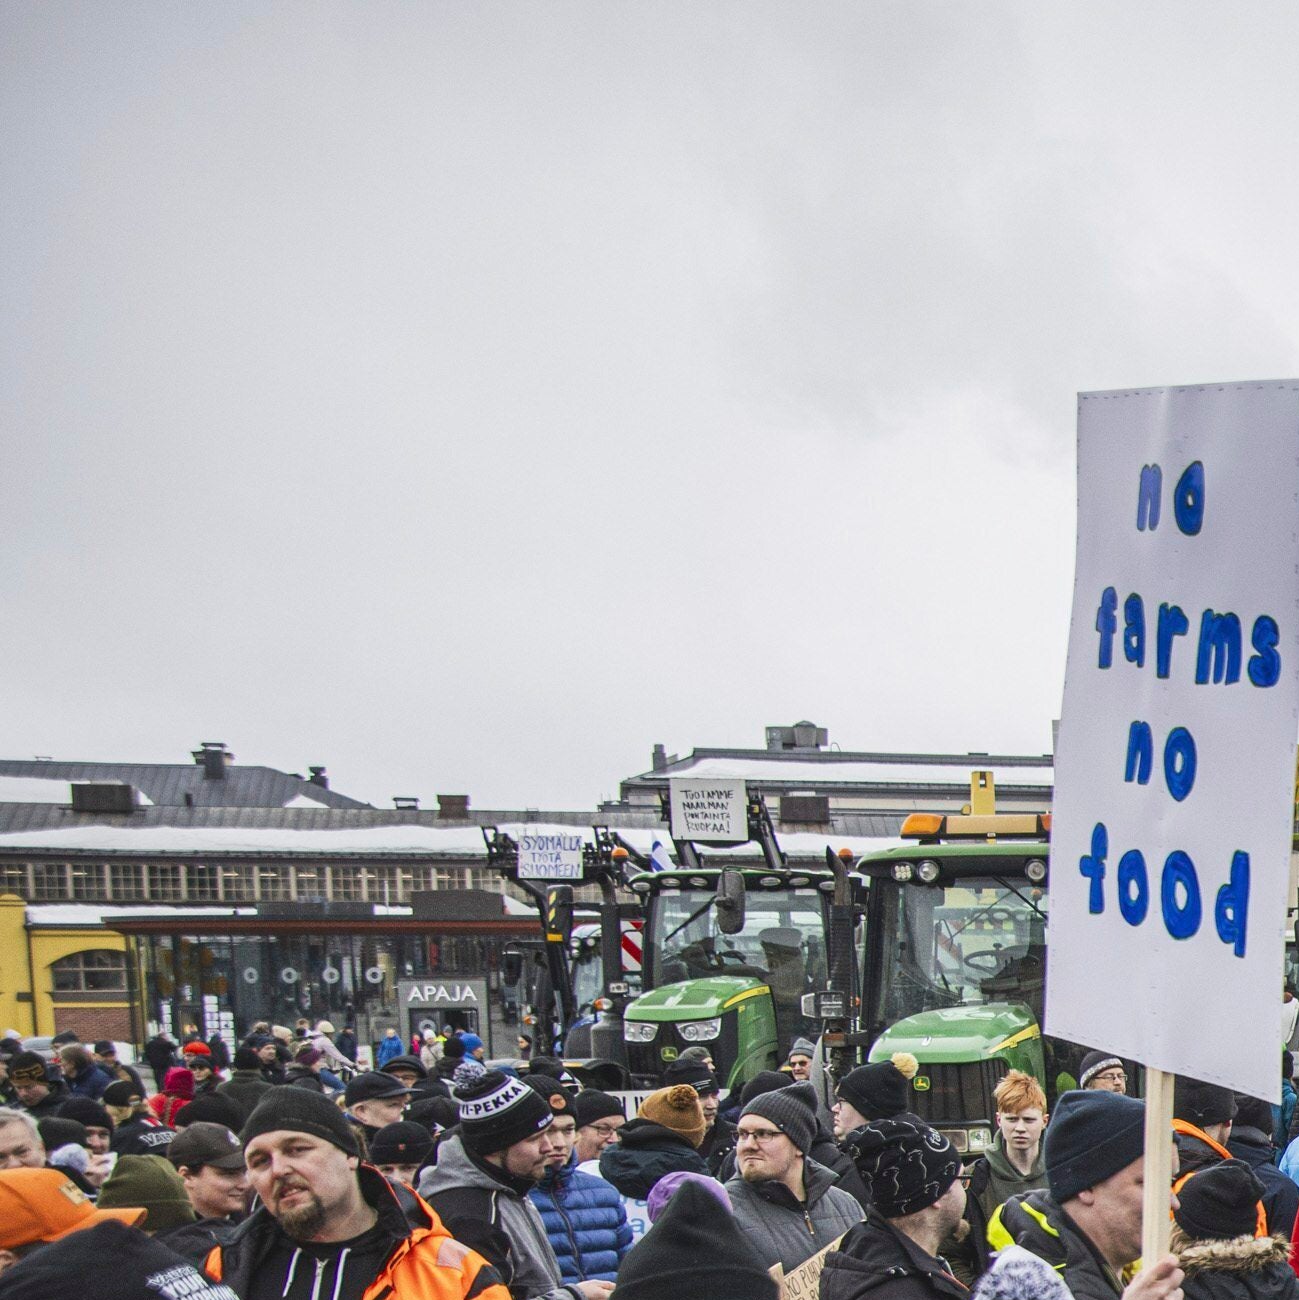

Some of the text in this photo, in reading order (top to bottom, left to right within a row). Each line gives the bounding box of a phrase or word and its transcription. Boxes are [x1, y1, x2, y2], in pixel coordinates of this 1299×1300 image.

[1137, 460, 1204, 536] no
[1096, 586, 1281, 687] farms
[1125, 720, 1198, 802] no
[1080, 822, 1250, 958] food
[408, 985, 478, 1002] APAJA
